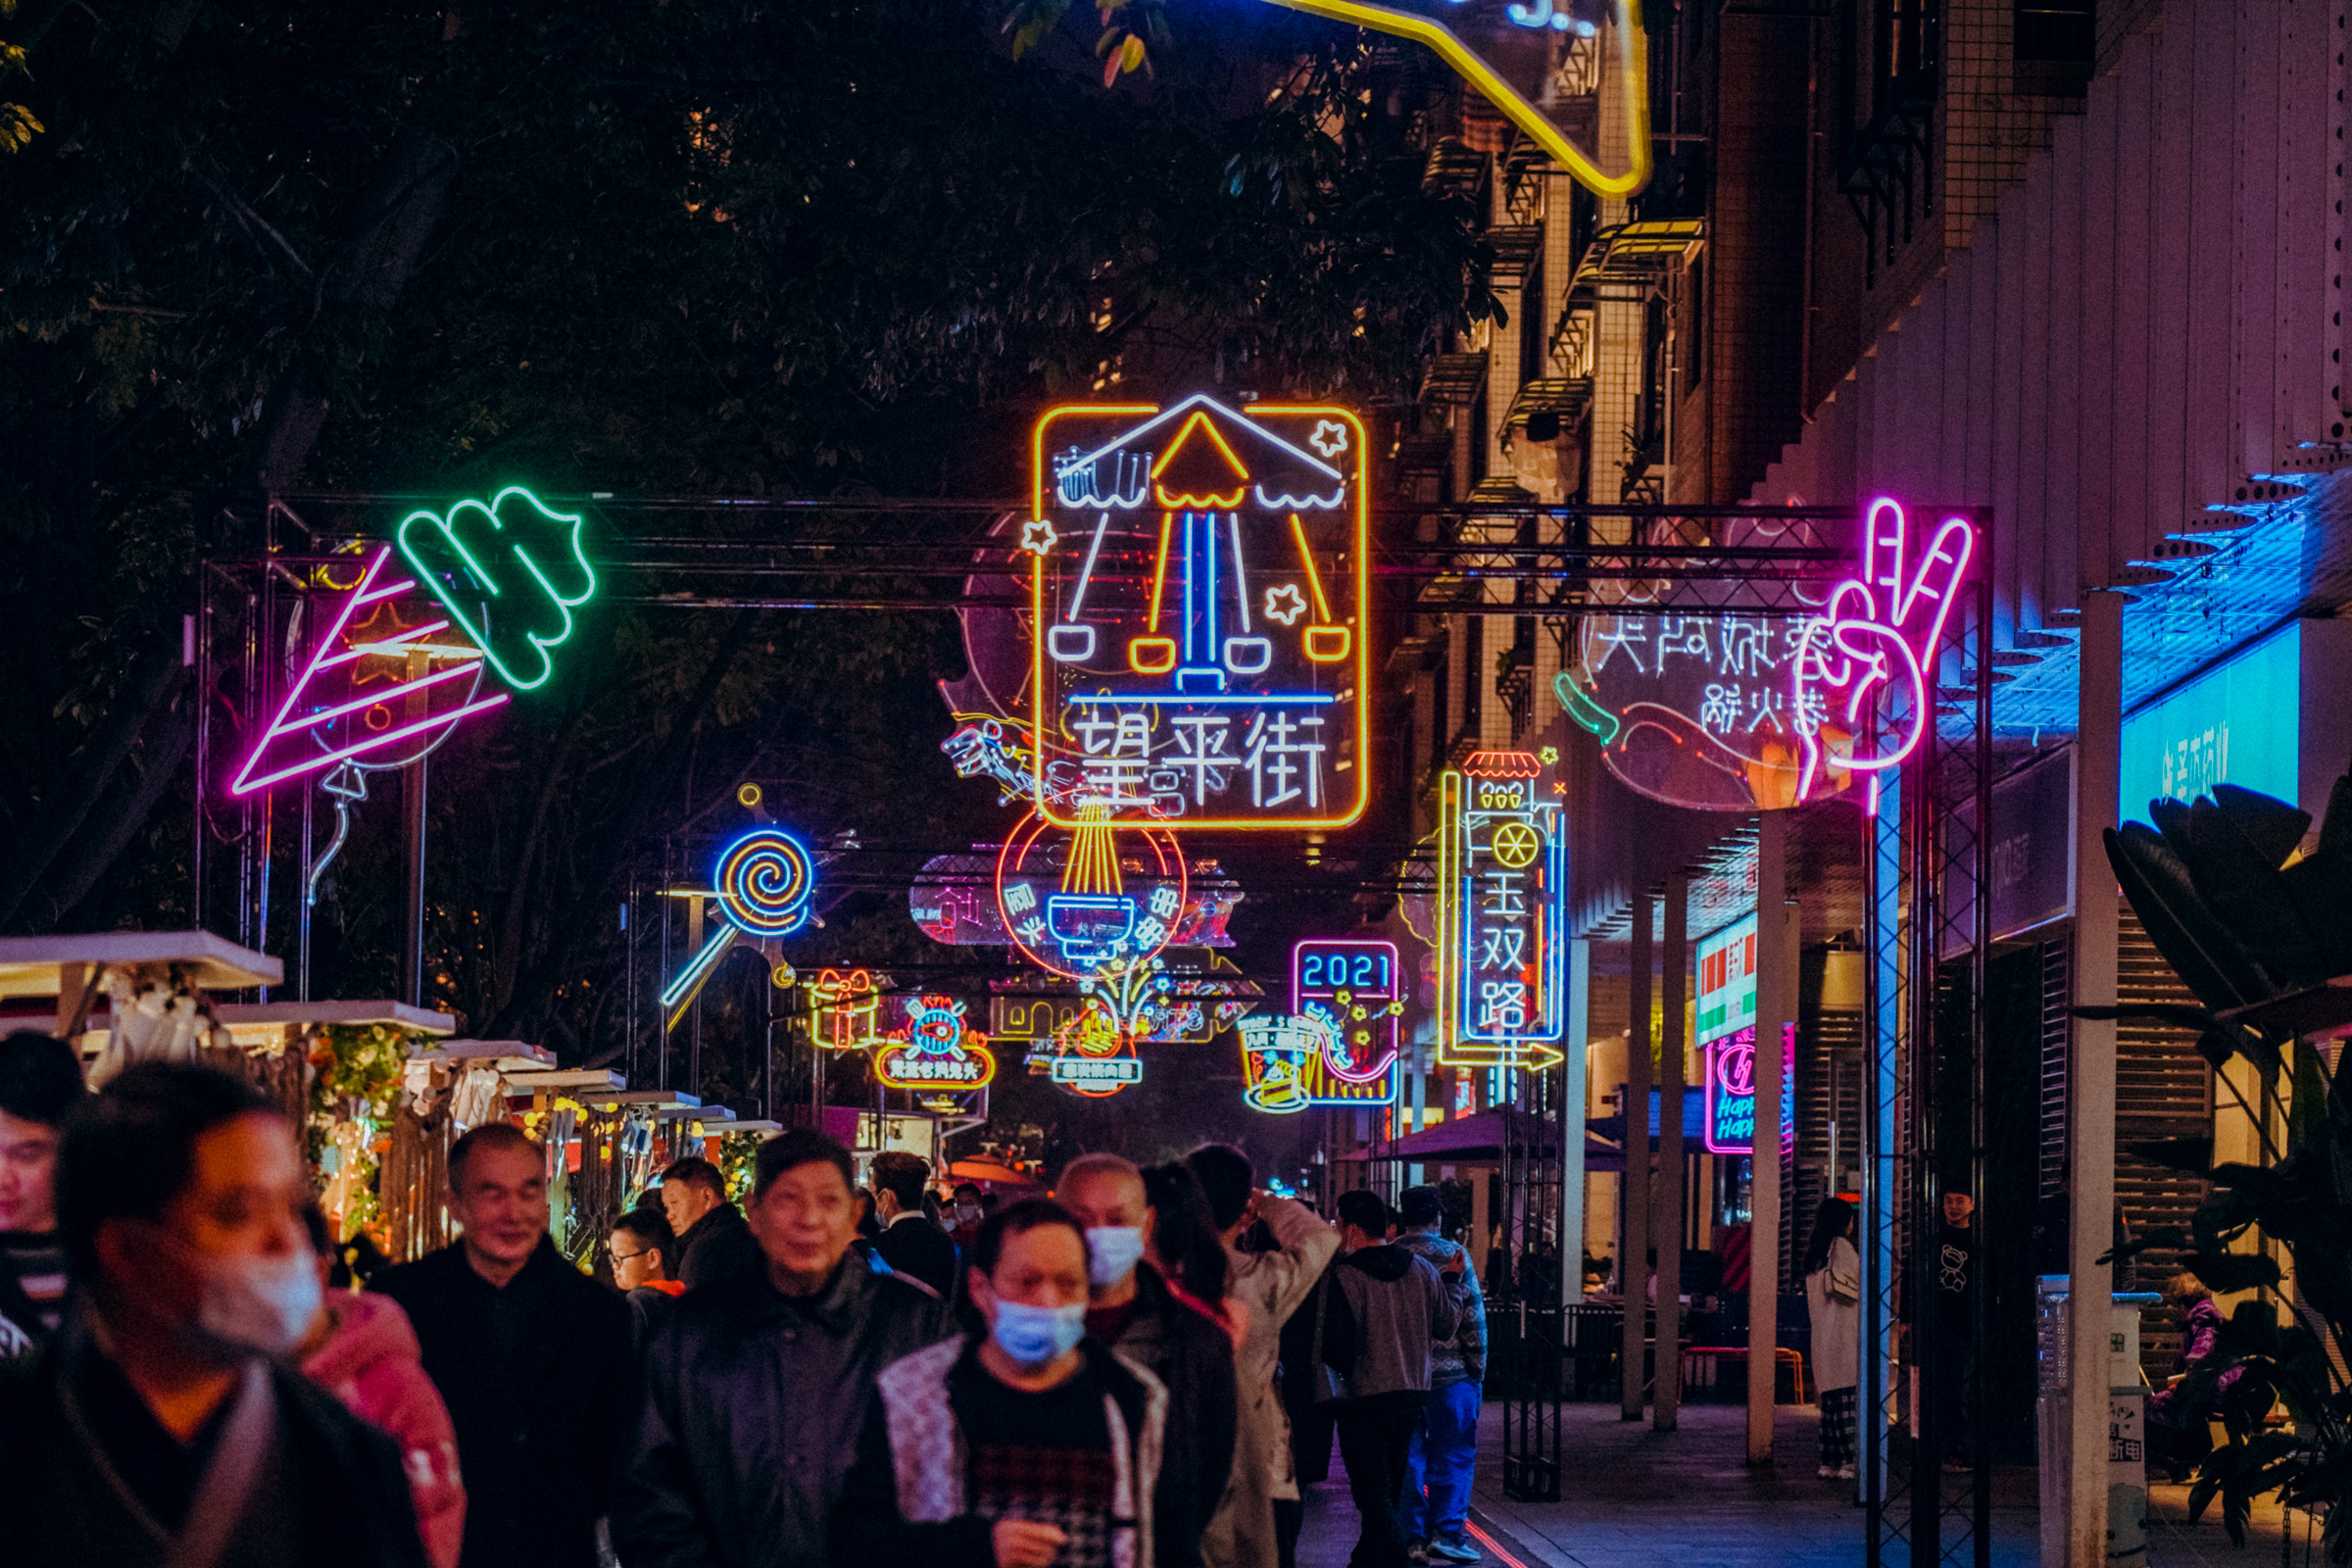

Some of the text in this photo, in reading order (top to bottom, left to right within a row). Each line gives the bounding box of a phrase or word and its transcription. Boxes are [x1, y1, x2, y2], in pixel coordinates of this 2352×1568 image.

[1072, 711, 1326, 808] 望平街
[1302, 955, 1389, 986] 2021
[1478, 871, 1526, 1029] 玉双路
